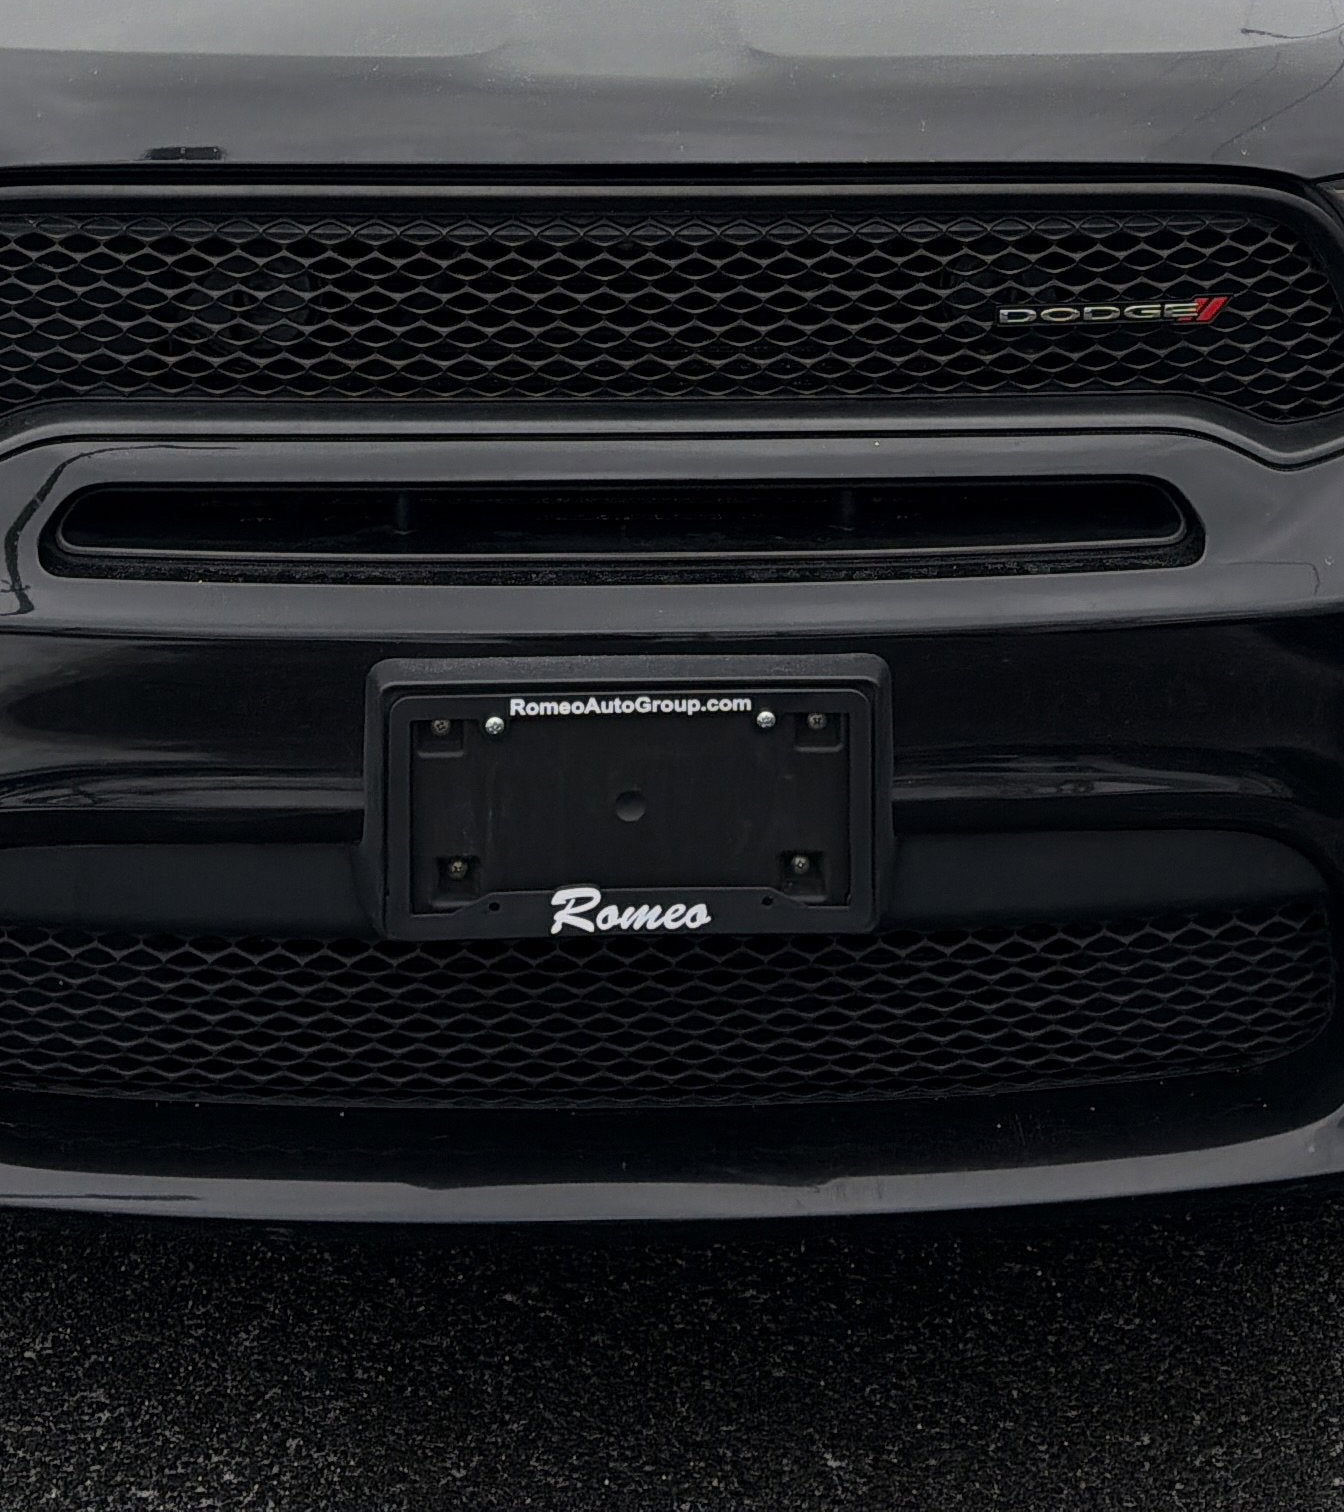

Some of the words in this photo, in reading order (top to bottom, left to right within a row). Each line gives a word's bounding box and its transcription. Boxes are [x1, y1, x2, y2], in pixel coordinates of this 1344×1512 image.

[999, 303, 1199, 323] DODGE
[509, 695, 752, 716] RomeoAutoGroup.com
[550, 887, 712, 935] Romeo
